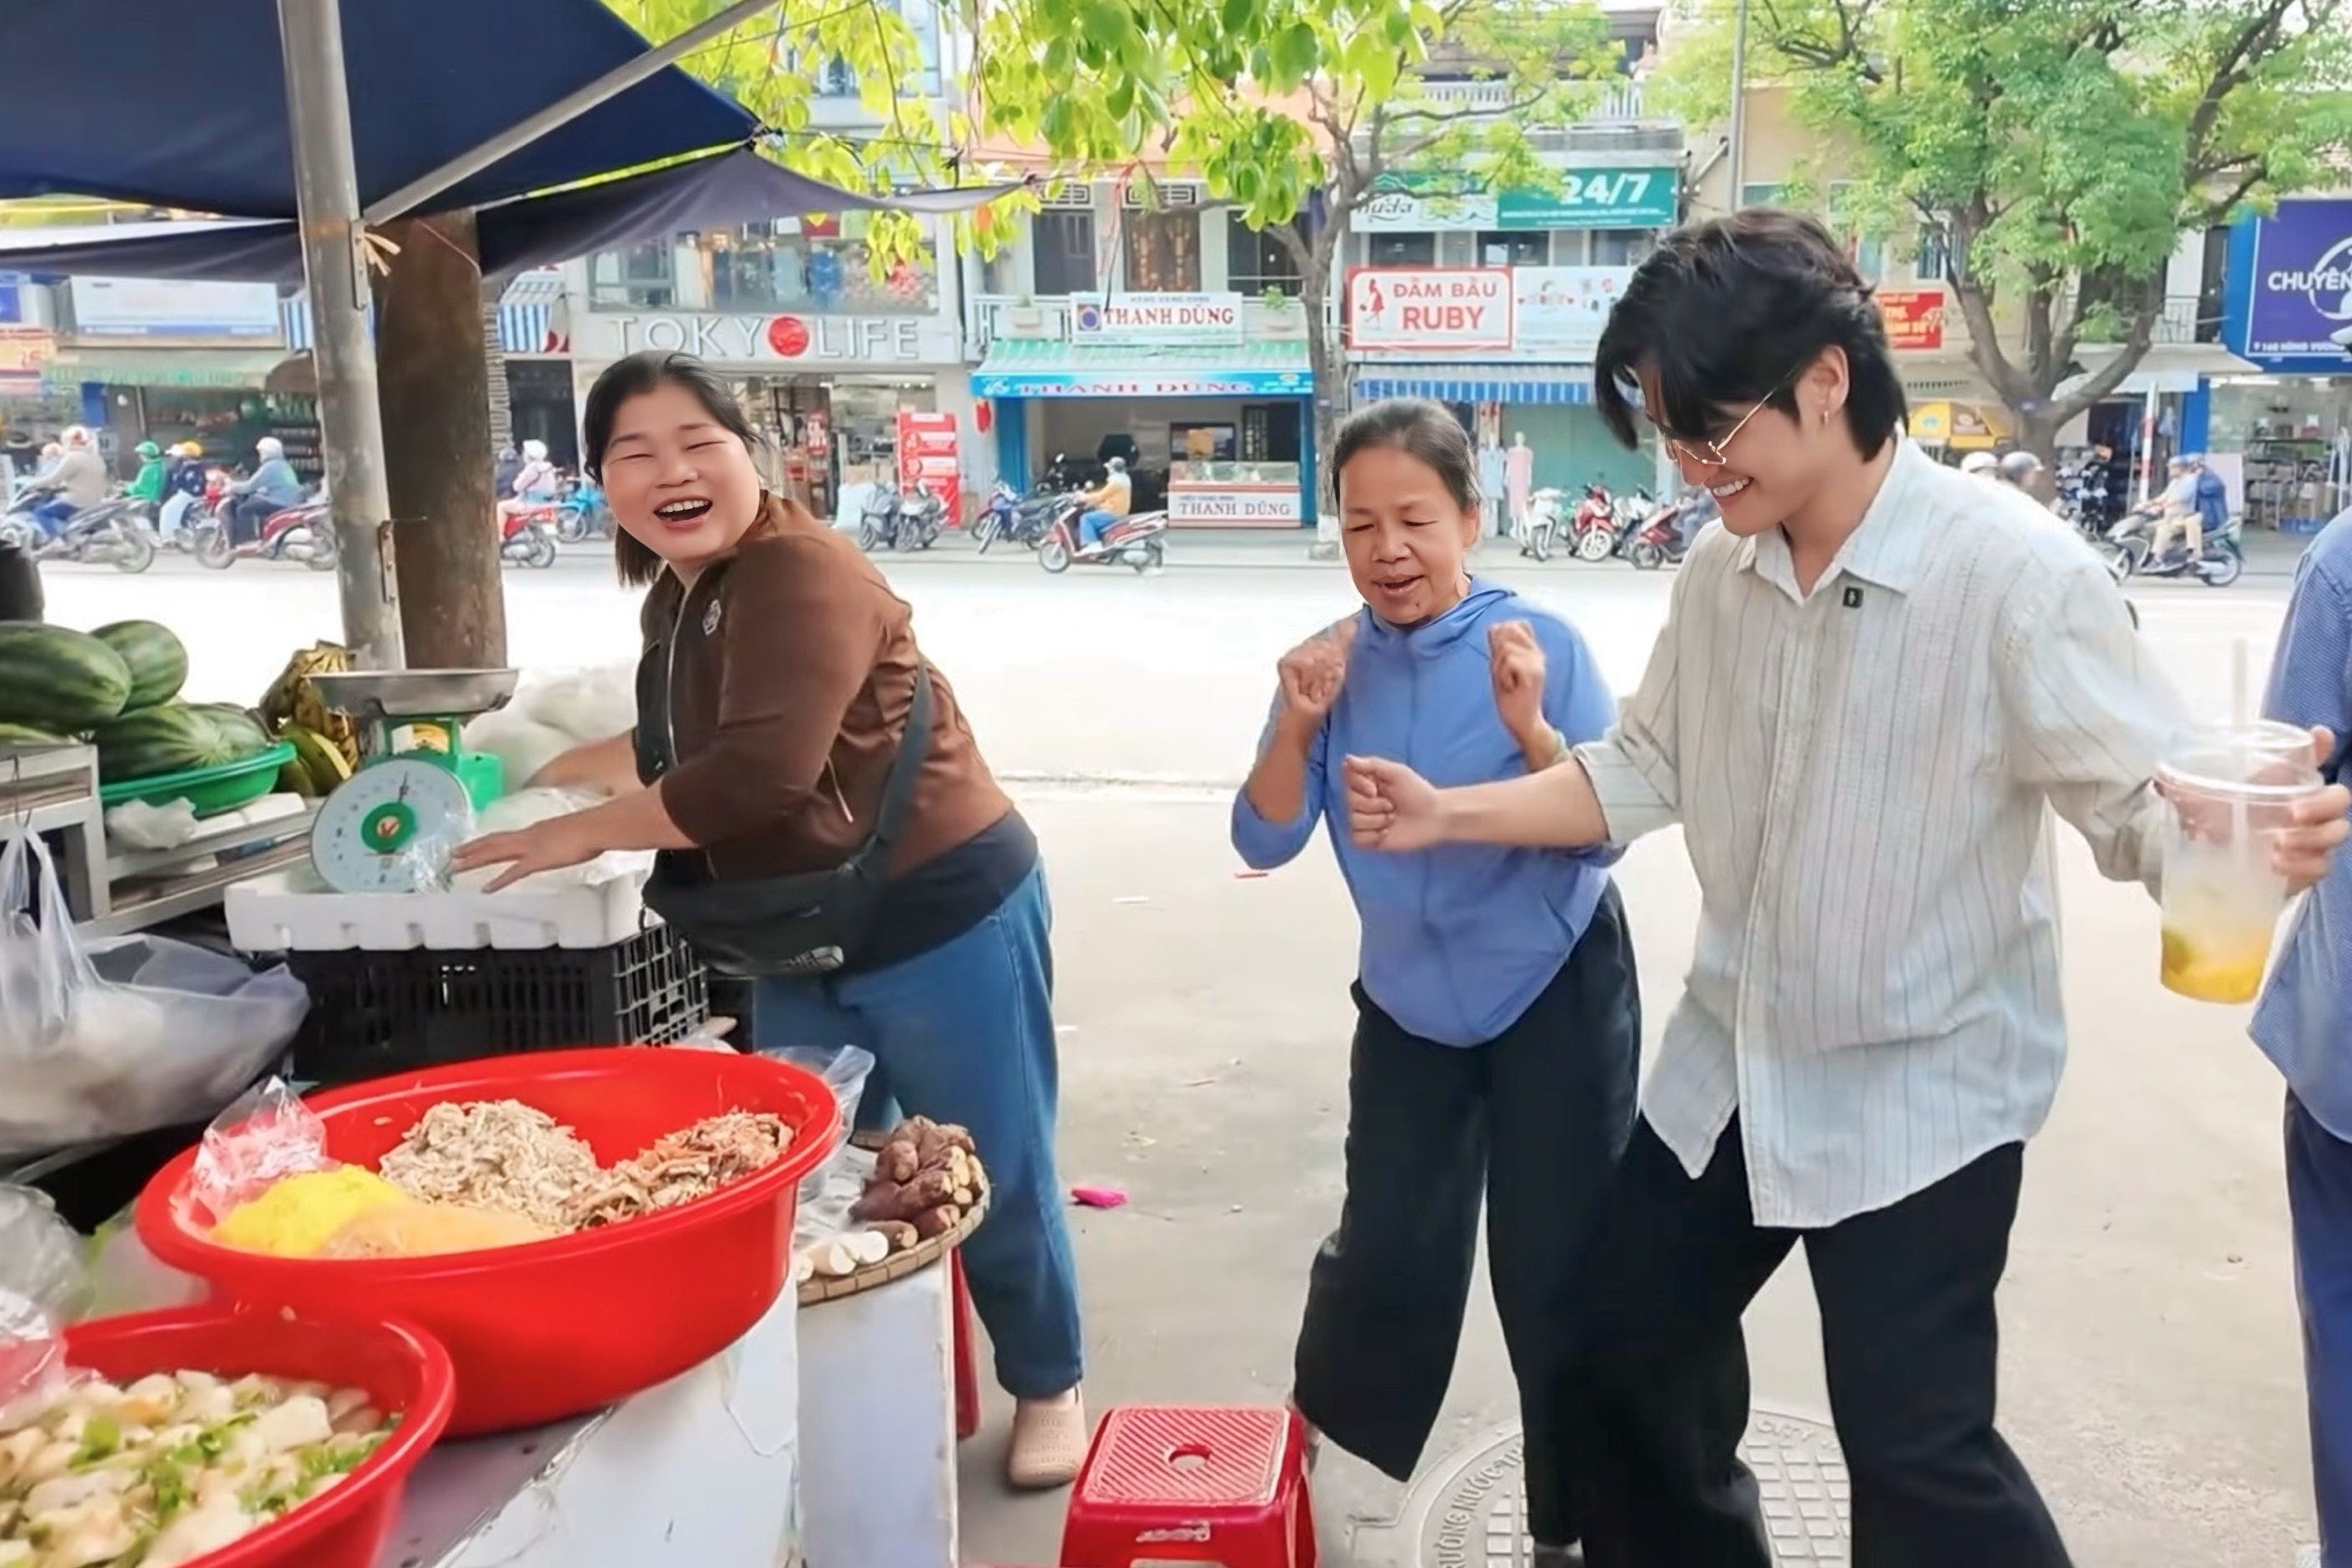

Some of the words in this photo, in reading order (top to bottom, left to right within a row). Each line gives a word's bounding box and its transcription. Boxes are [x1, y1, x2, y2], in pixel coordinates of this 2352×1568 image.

[1559, 172, 1651, 206] 24/7
[1104, 307, 1173, 325] THANH
[1402, 306, 1485, 331] RUBY
[1179, 503, 1237, 515] THANH
